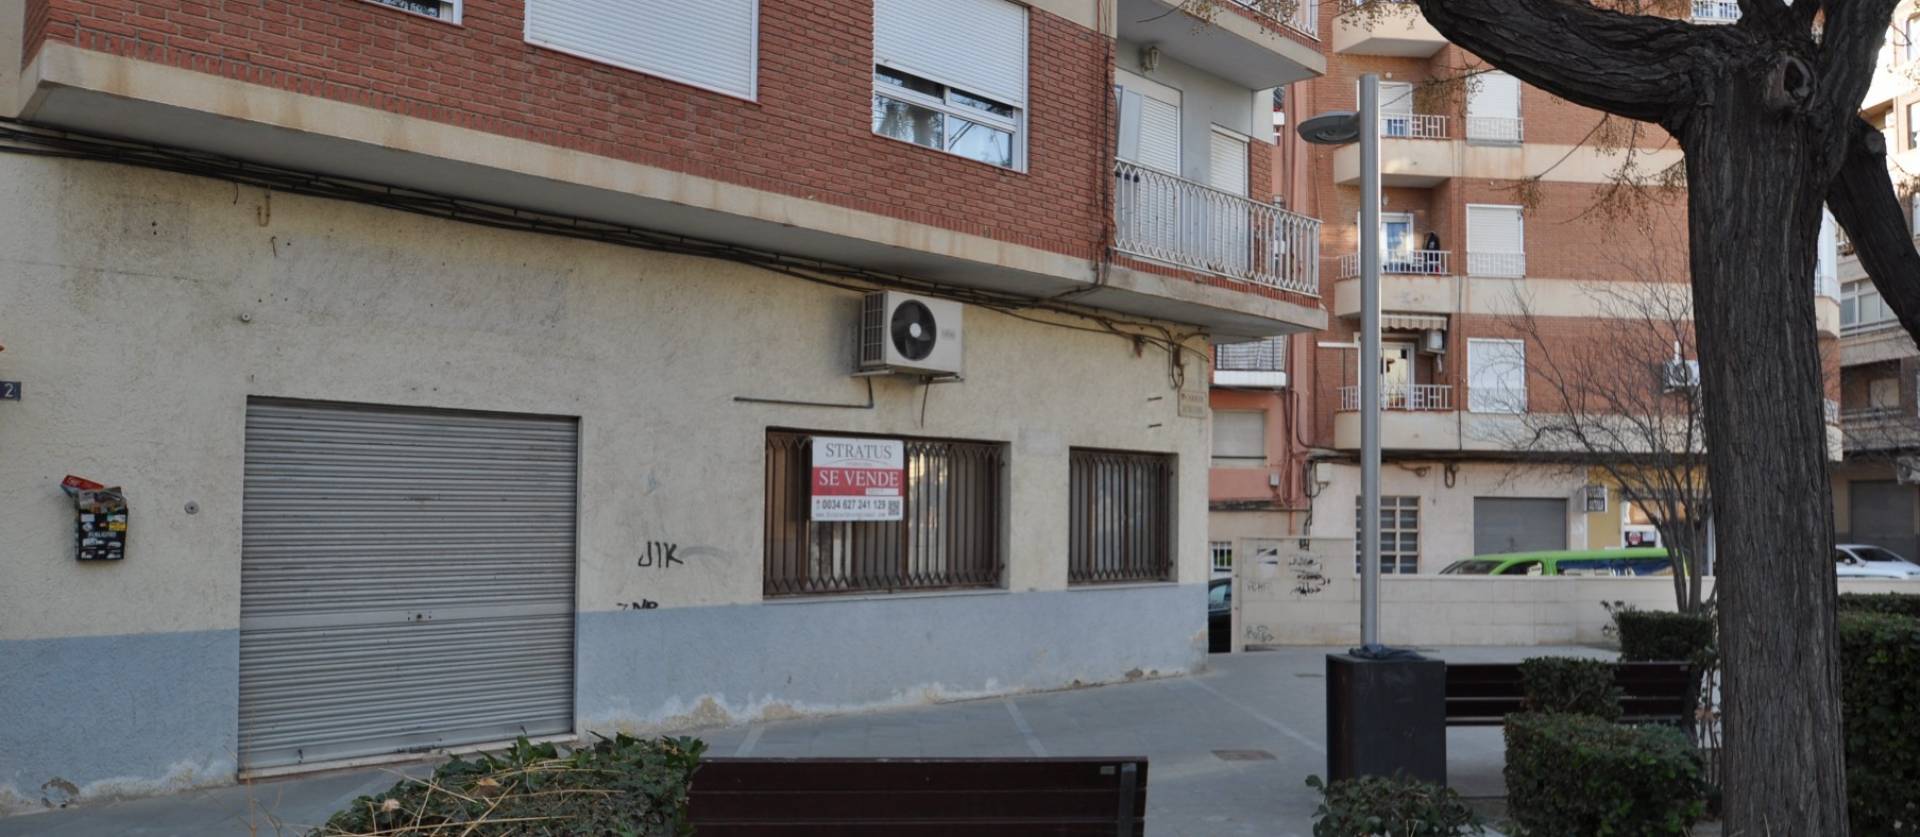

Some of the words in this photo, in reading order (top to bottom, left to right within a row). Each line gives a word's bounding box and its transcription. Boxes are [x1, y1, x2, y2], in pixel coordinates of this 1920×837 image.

[4, 382, 14, 398] 2
[825, 442, 892, 459] STRATUS
[819, 470, 839, 486] SE
[844, 470, 899, 487] VENDE
[822, 499, 841, 510] 0034
[842, 499, 856, 510] 627
